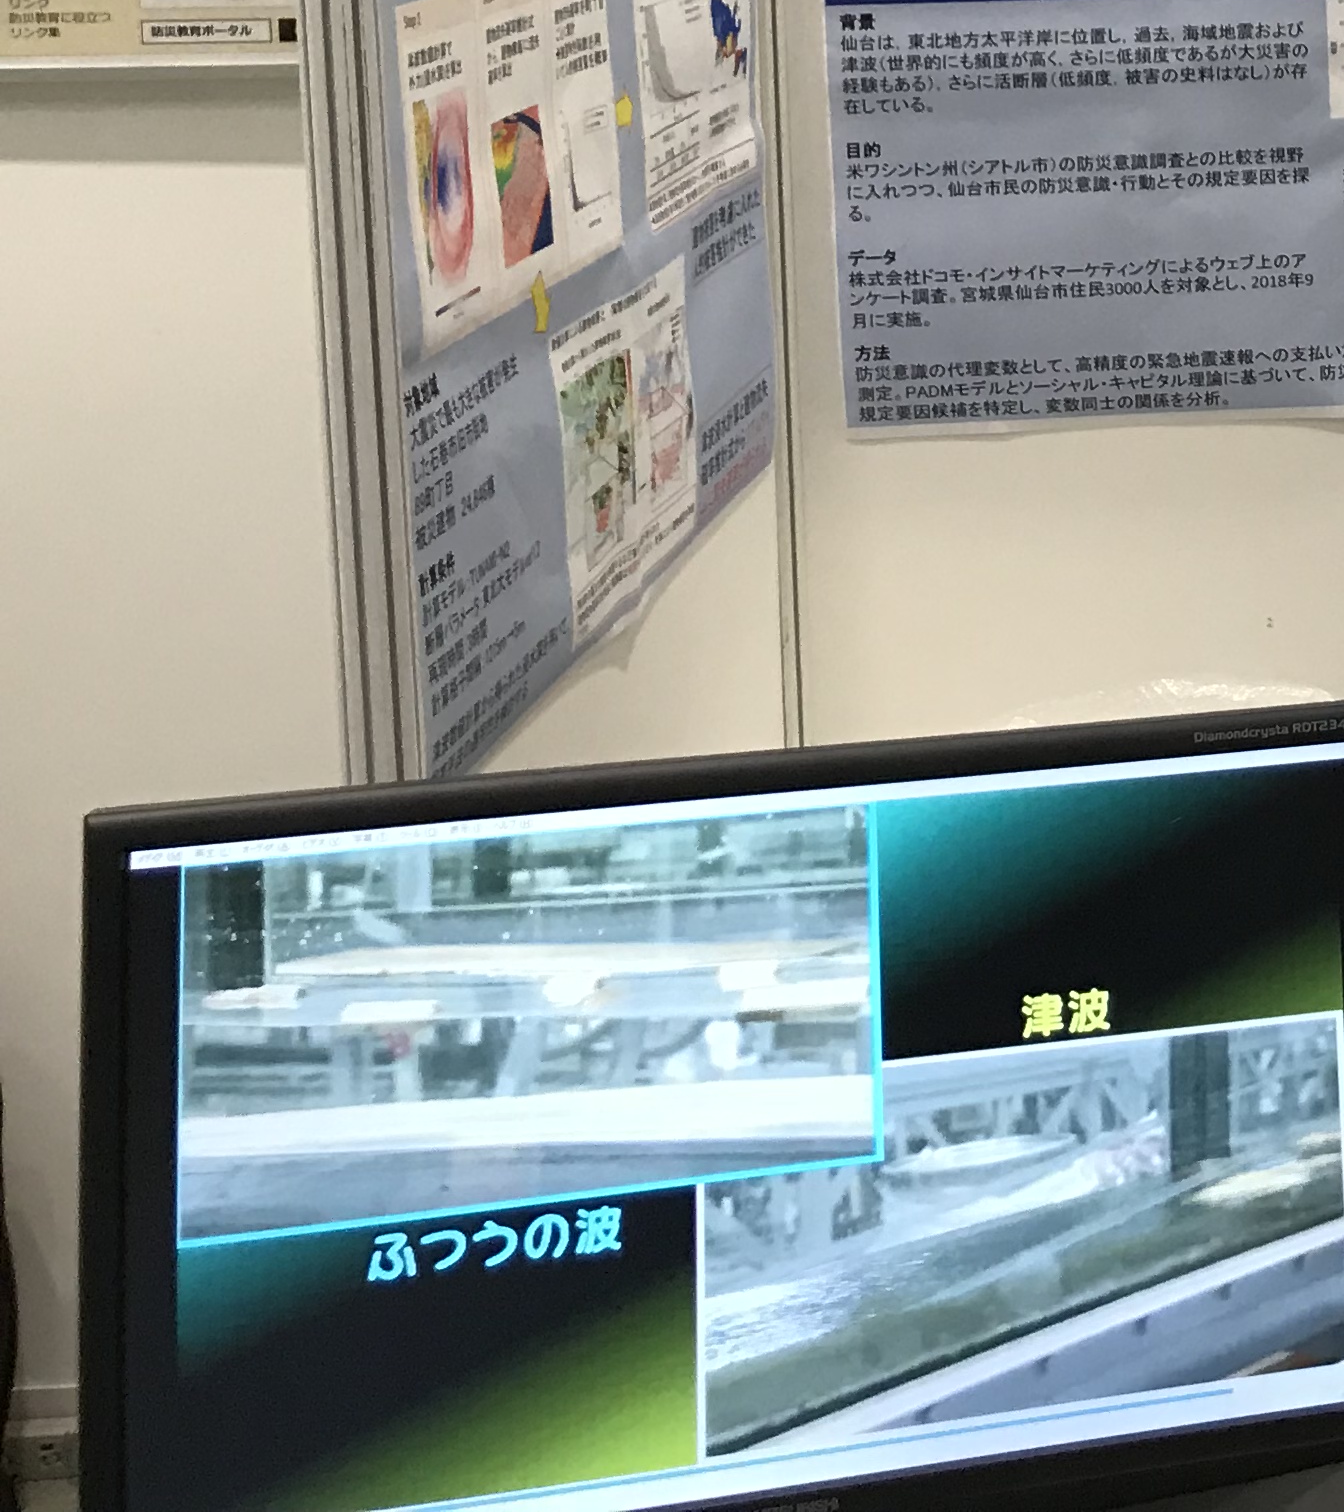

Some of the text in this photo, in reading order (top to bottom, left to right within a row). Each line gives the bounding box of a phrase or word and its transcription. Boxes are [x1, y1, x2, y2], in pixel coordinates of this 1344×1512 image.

[839, 13, 875, 31] 背景
[852, 311, 933, 330] 月に実施。
[1020, 988, 1111, 1039] 津波
[366, 1204, 624, 1284] ふつうの波
